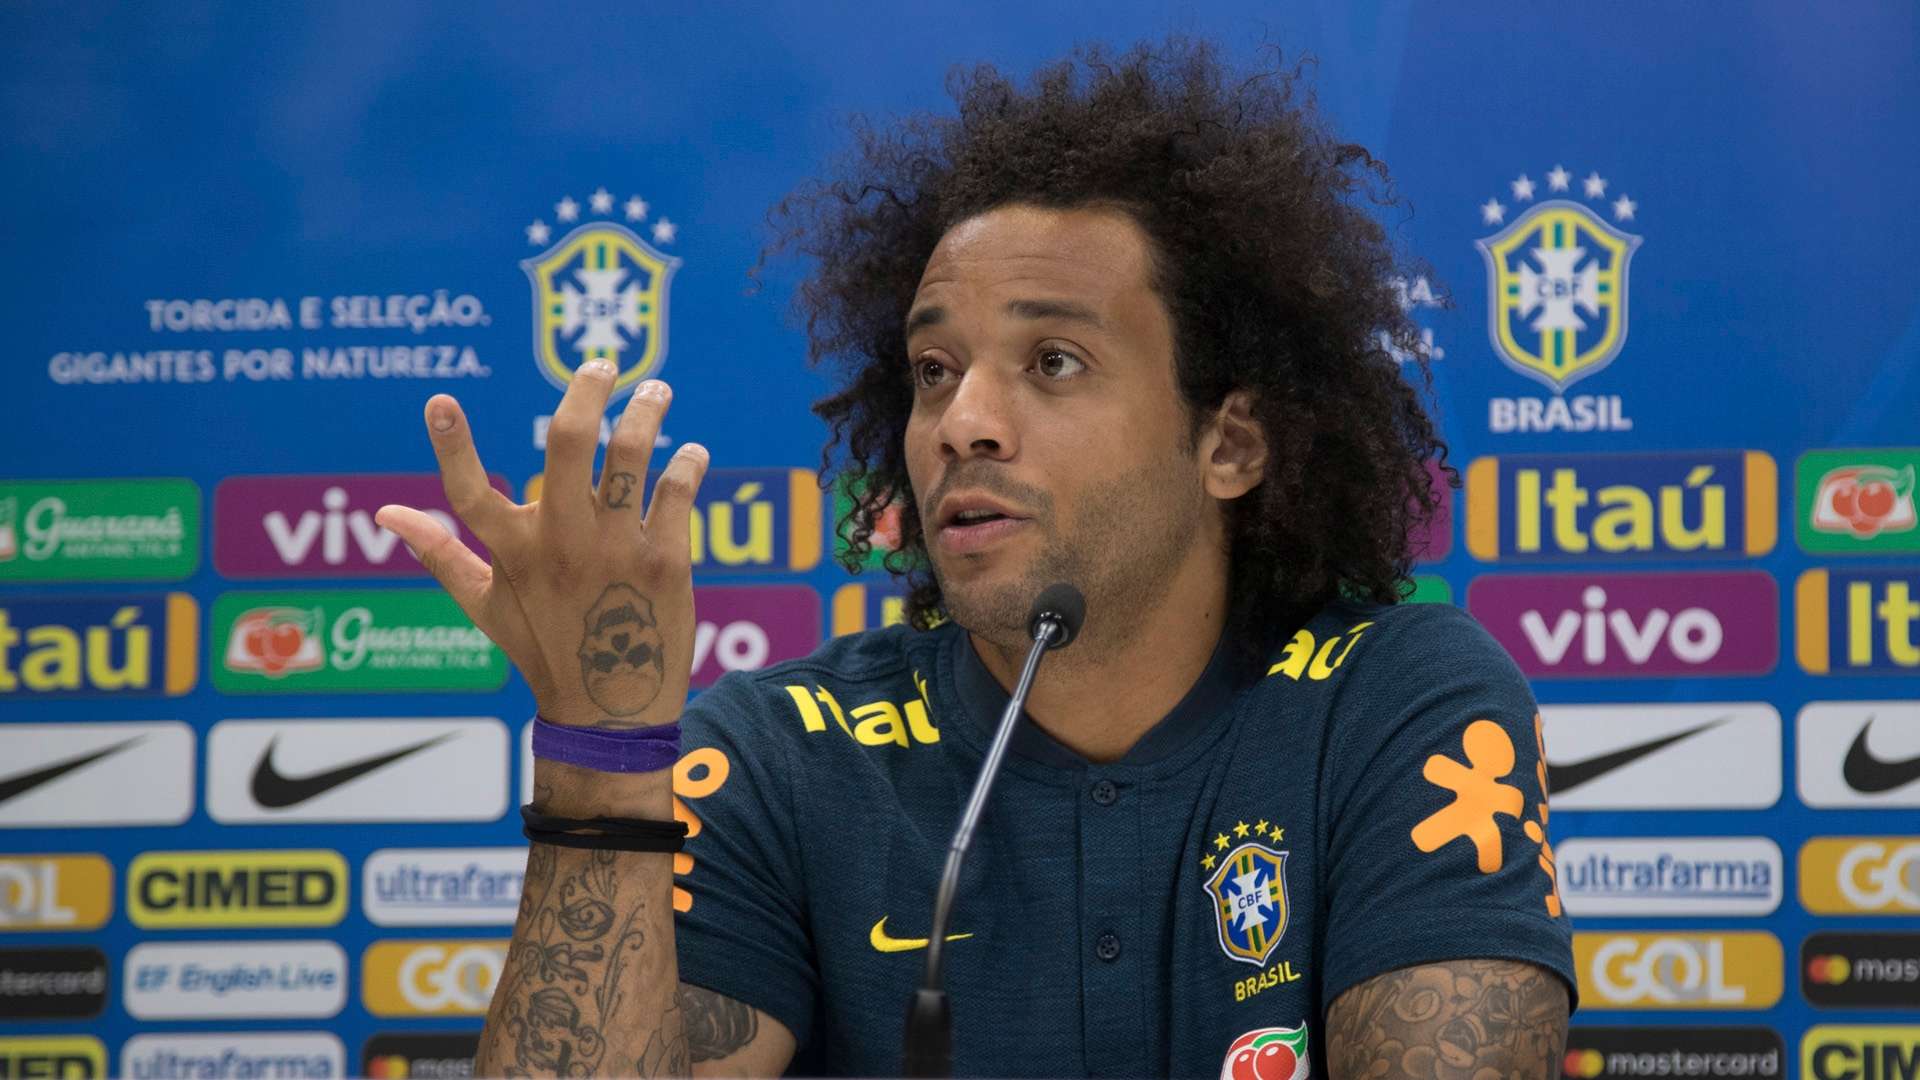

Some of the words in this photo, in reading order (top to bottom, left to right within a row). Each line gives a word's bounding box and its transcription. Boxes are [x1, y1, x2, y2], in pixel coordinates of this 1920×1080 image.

[1538, 276, 1583, 299] CBF
[147, 298, 292, 333] TORCIDA
[300, 296, 323, 329] E
[331, 289, 491, 334] SELEÇÃO.
[578, 297, 625, 318] CBF
[49, 350, 214, 385] GIGANTES
[224, 347, 294, 381] POR
[302, 345, 491, 380] NATUREZA.
[1489, 396, 1632, 433] BRASIL
[1515, 465, 1726, 553] Itaú
[1519, 585, 1724, 664] vivo
[138, 867, 337, 912] CIMED
[1565, 855, 1772, 893] ultrafarma
[1237, 890, 1263, 911] CBF
[135, 966, 169, 992] EF
[179, 964, 275, 995] English
[281, 962, 337, 990] Live
[1234, 961, 1301, 1002] BRASIL
[1591, 938, 1746, 1003] GOL
[132, 1048, 332, 1080] ultrafarma
[1607, 1050, 1779, 1076] mastercard
